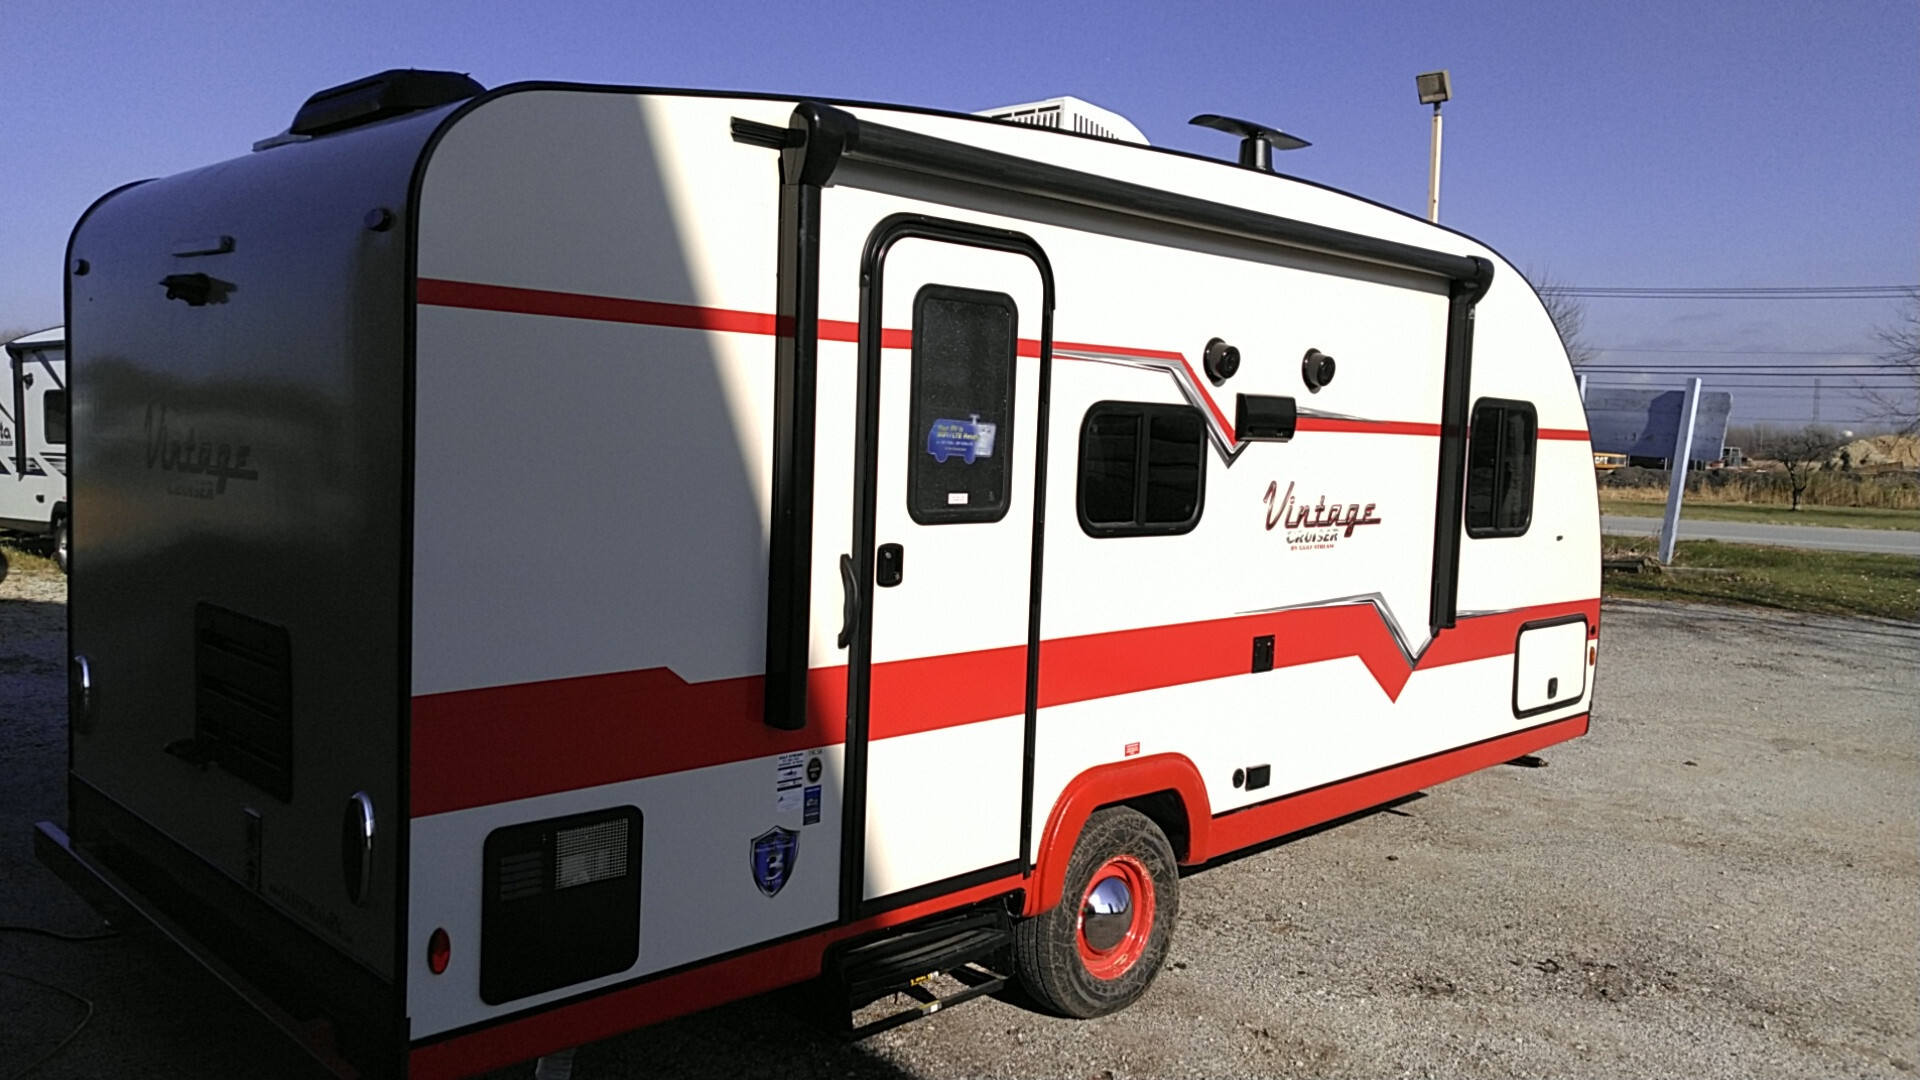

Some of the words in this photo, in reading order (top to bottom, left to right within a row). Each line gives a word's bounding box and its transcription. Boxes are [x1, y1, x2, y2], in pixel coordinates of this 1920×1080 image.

[144, 402, 258, 495] Vintage
[1263, 480, 1381, 538] Vintage
[1286, 528, 1338, 544] CRUISER
[765, 853, 783, 880] 3
